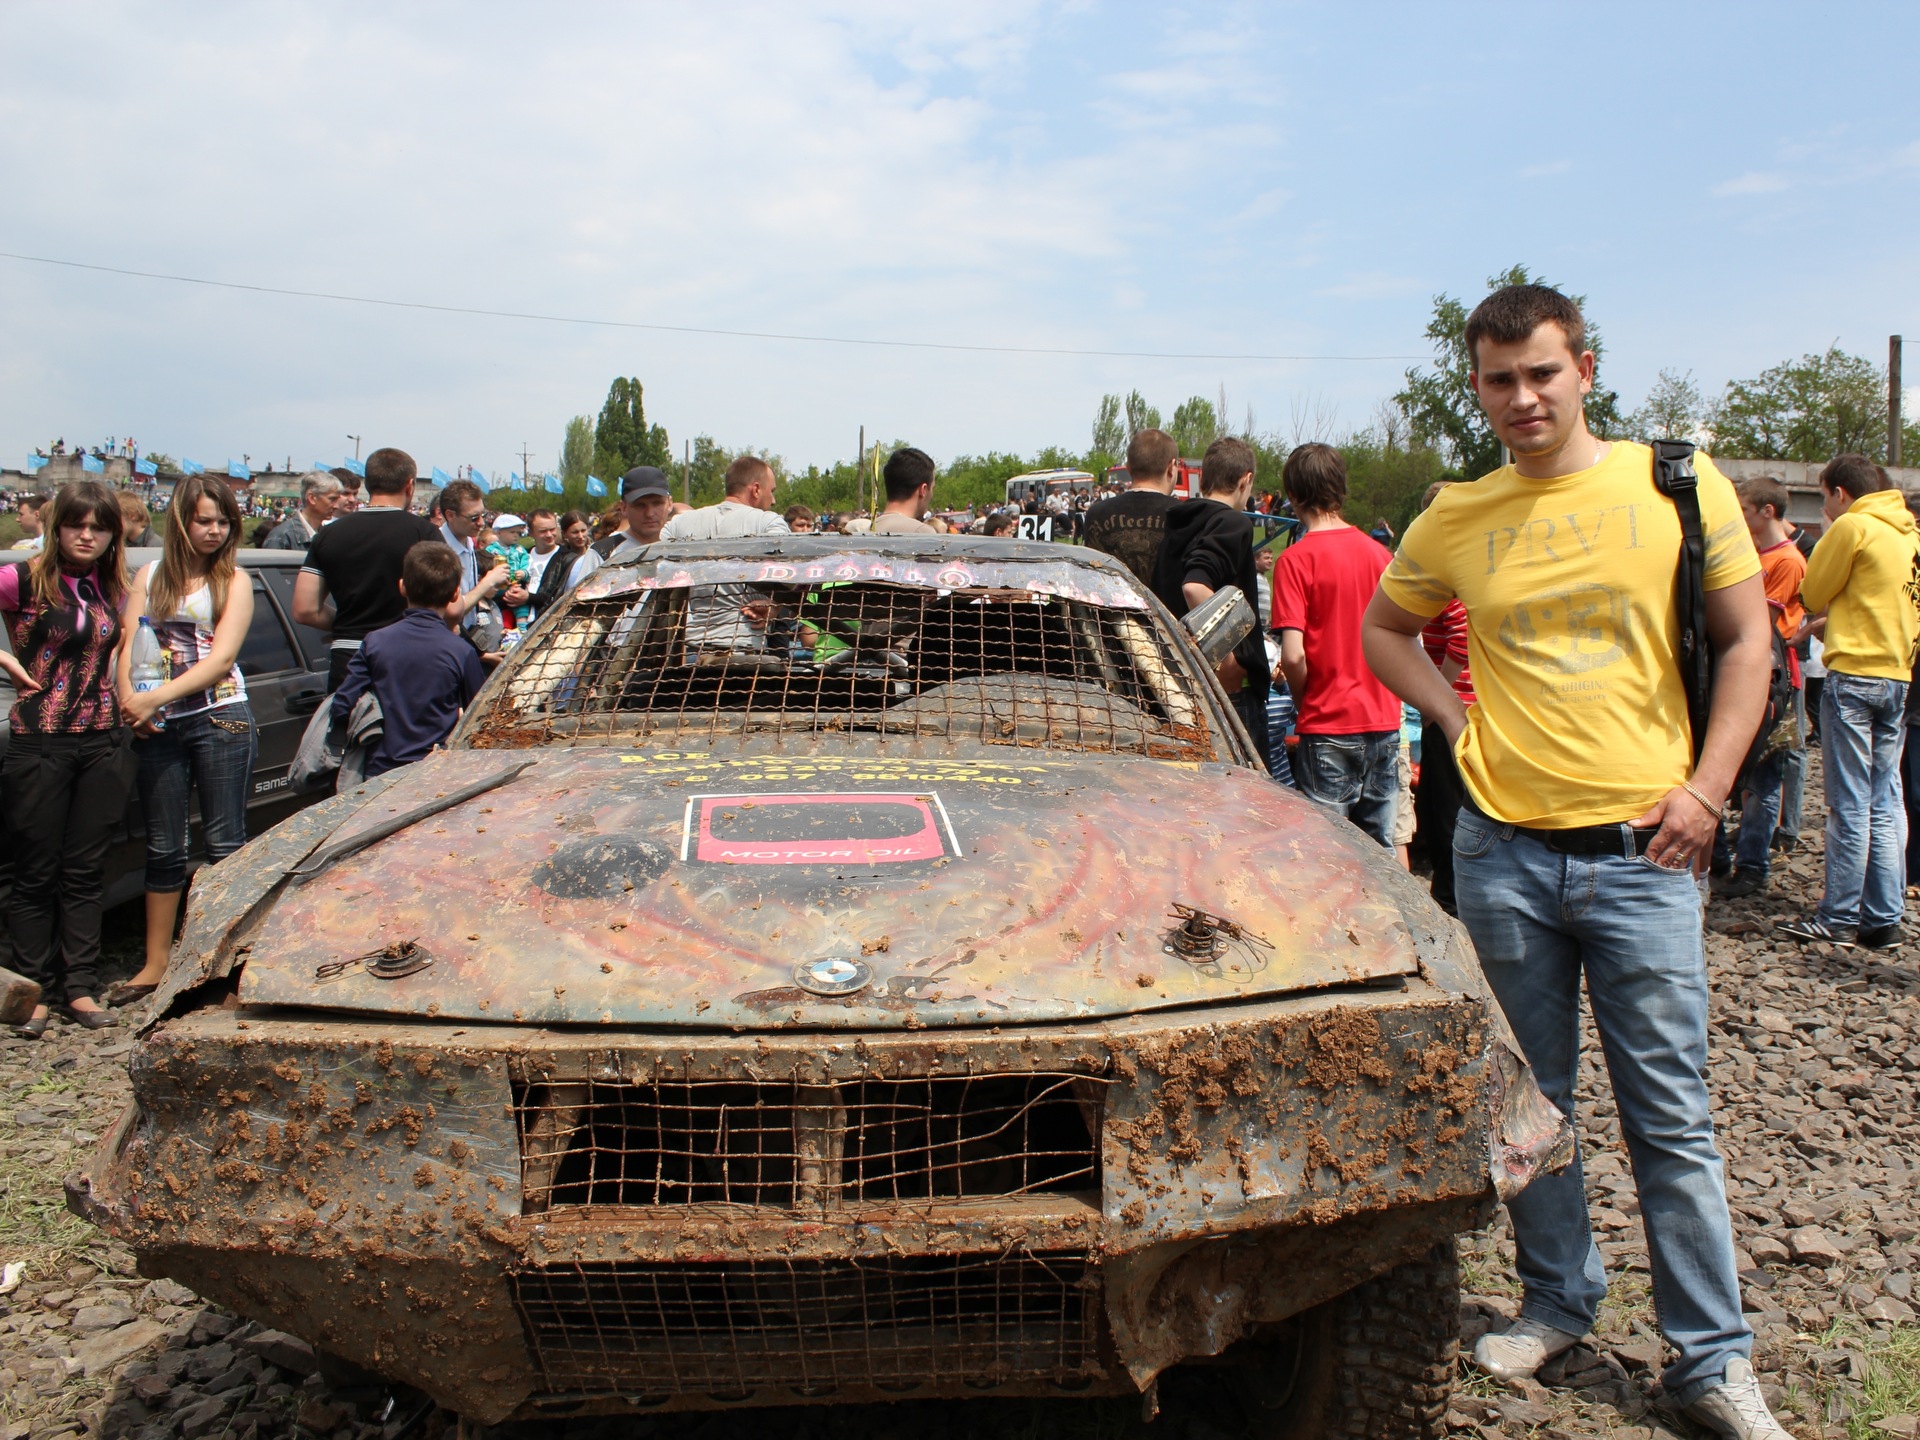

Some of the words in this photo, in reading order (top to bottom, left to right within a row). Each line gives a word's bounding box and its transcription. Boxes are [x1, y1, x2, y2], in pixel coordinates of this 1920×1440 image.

[1020, 516, 1053, 541] 31
[1088, 514, 1166, 542] Reflecti
[1483, 504, 1650, 575] PRVT
[1561, 679, 1612, 692] ORIGIN
[617, 753, 710, 763] ВСЕ
[764, 764, 981, 776] 220-33-79
[254, 776, 288, 793] sama
[738, 773, 816, 781] 067
[852, 773, 1022, 784] 8810440
[720, 850, 853, 859] MOTOR
[867, 848, 921, 857] OIL
